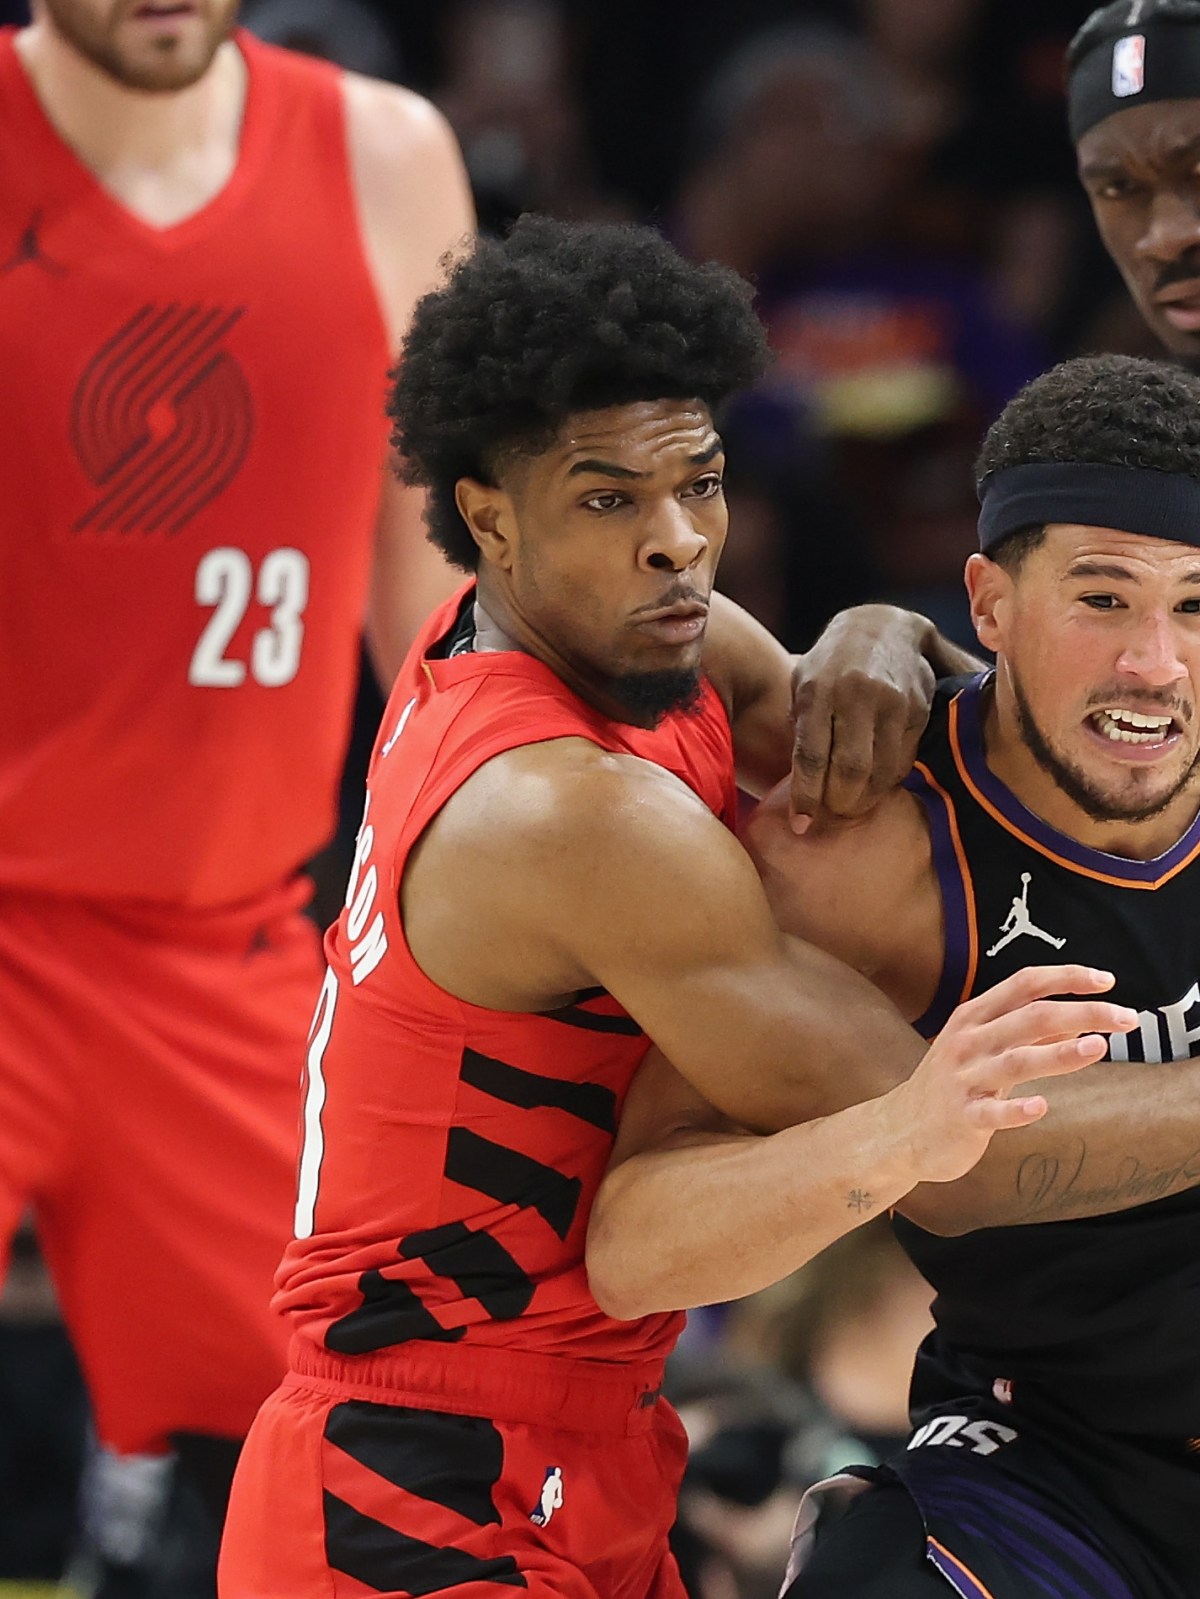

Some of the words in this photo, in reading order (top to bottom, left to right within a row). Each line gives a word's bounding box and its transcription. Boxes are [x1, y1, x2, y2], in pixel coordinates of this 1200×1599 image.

[187, 546, 311, 688] 23
[345, 789, 388, 987] SON
[907, 1415, 1018, 1456] NS
